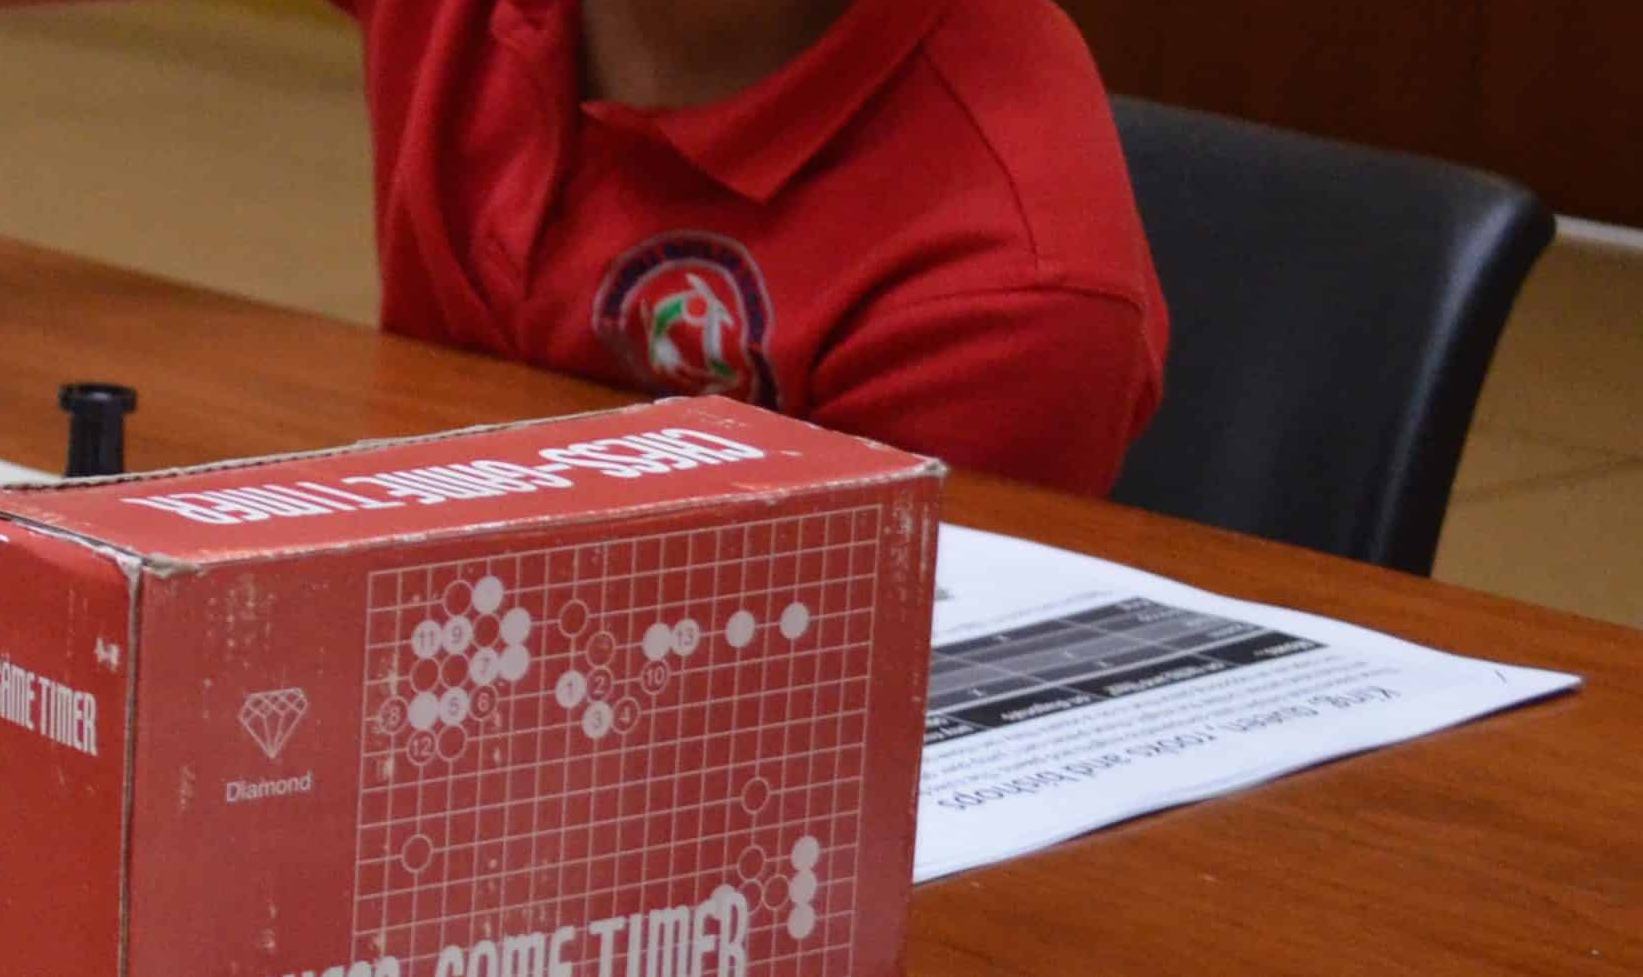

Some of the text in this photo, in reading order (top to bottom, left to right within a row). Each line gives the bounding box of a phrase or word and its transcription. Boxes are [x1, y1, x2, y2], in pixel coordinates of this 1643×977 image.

[120, 428, 765, 524] CHESS-GAME TIMER
[647, 666, 665, 687] 10
[477, 692, 490, 713] 6
[38, 675, 98, 756] TIMER
[618, 705, 631, 723] 4
[412, 736, 433, 758] 12
[226, 769, 315, 803] Diamond
